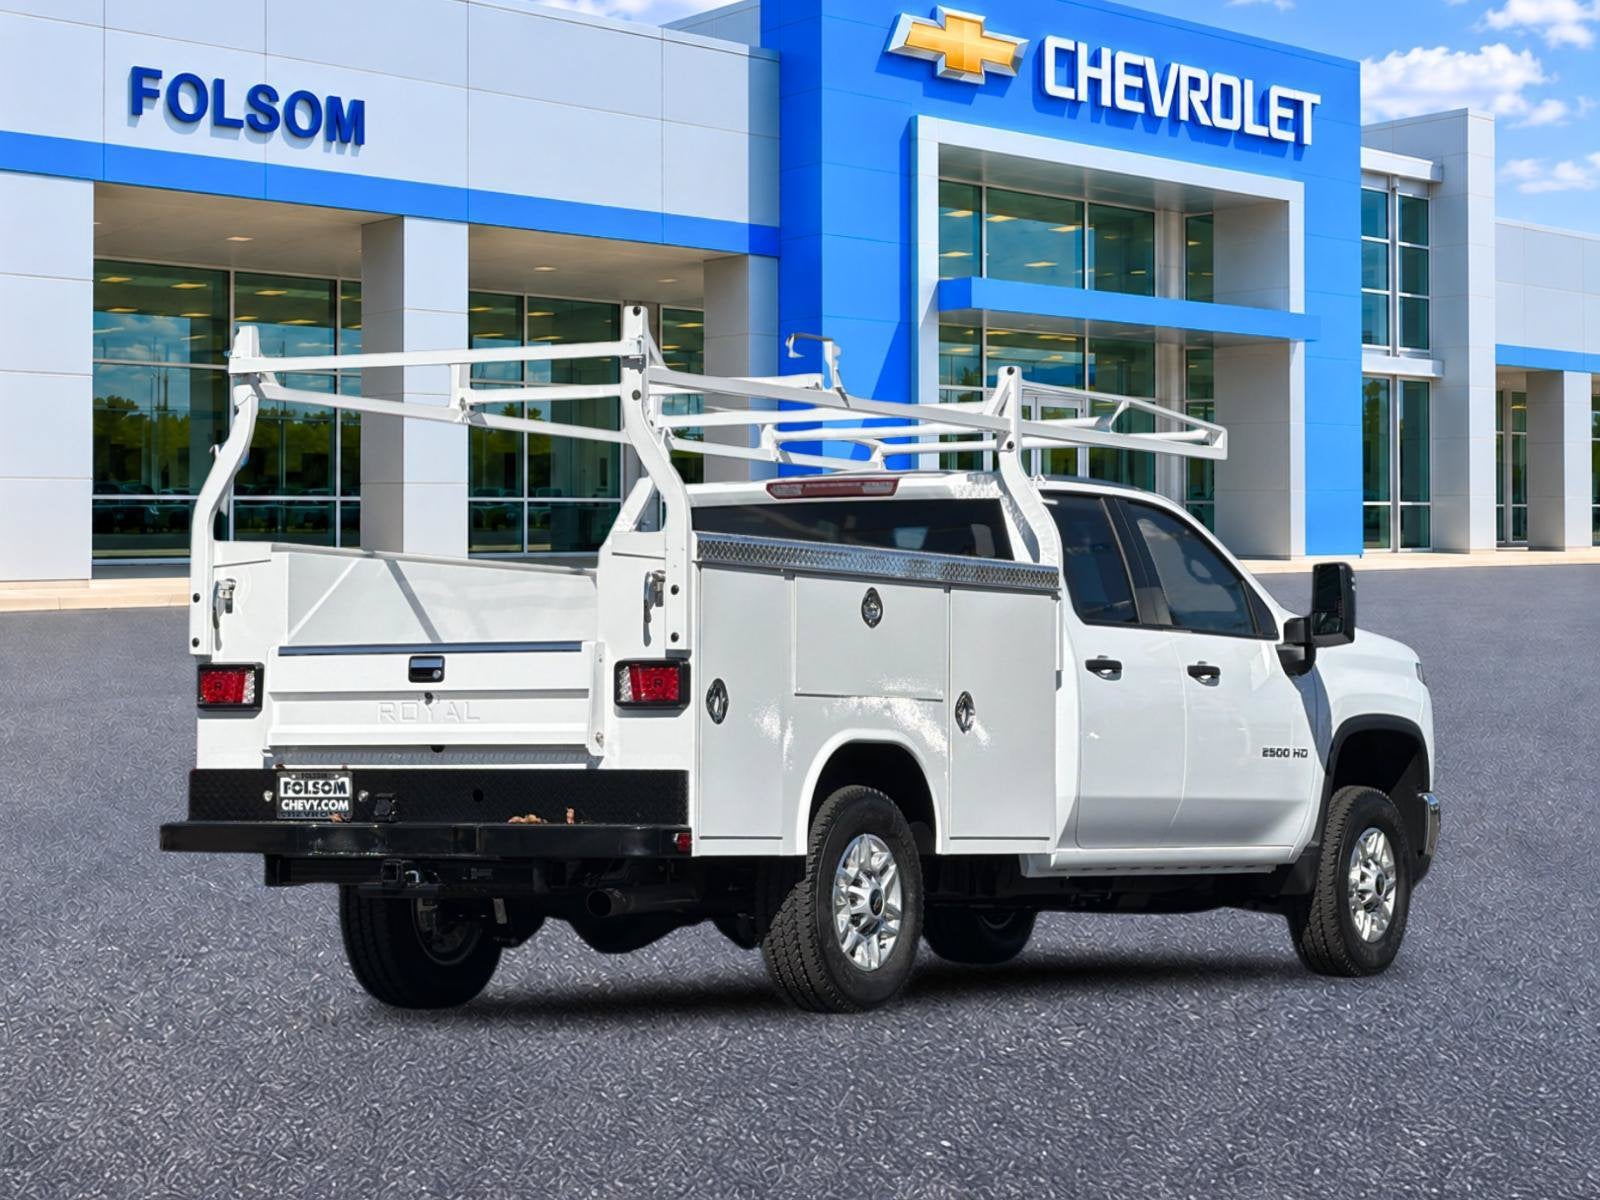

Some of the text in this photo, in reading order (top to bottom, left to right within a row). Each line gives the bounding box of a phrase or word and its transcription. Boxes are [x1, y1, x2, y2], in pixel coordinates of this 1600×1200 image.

[1043, 35, 1321, 146] CHEVROLET
[130, 65, 366, 146] FOLSOM
[378, 702, 480, 722] ROYAL
[1262, 747, 1308, 758] 2500 HD
[283, 781, 347, 795] FOLSOM
[281, 799, 349, 811] CHEVY.COM
